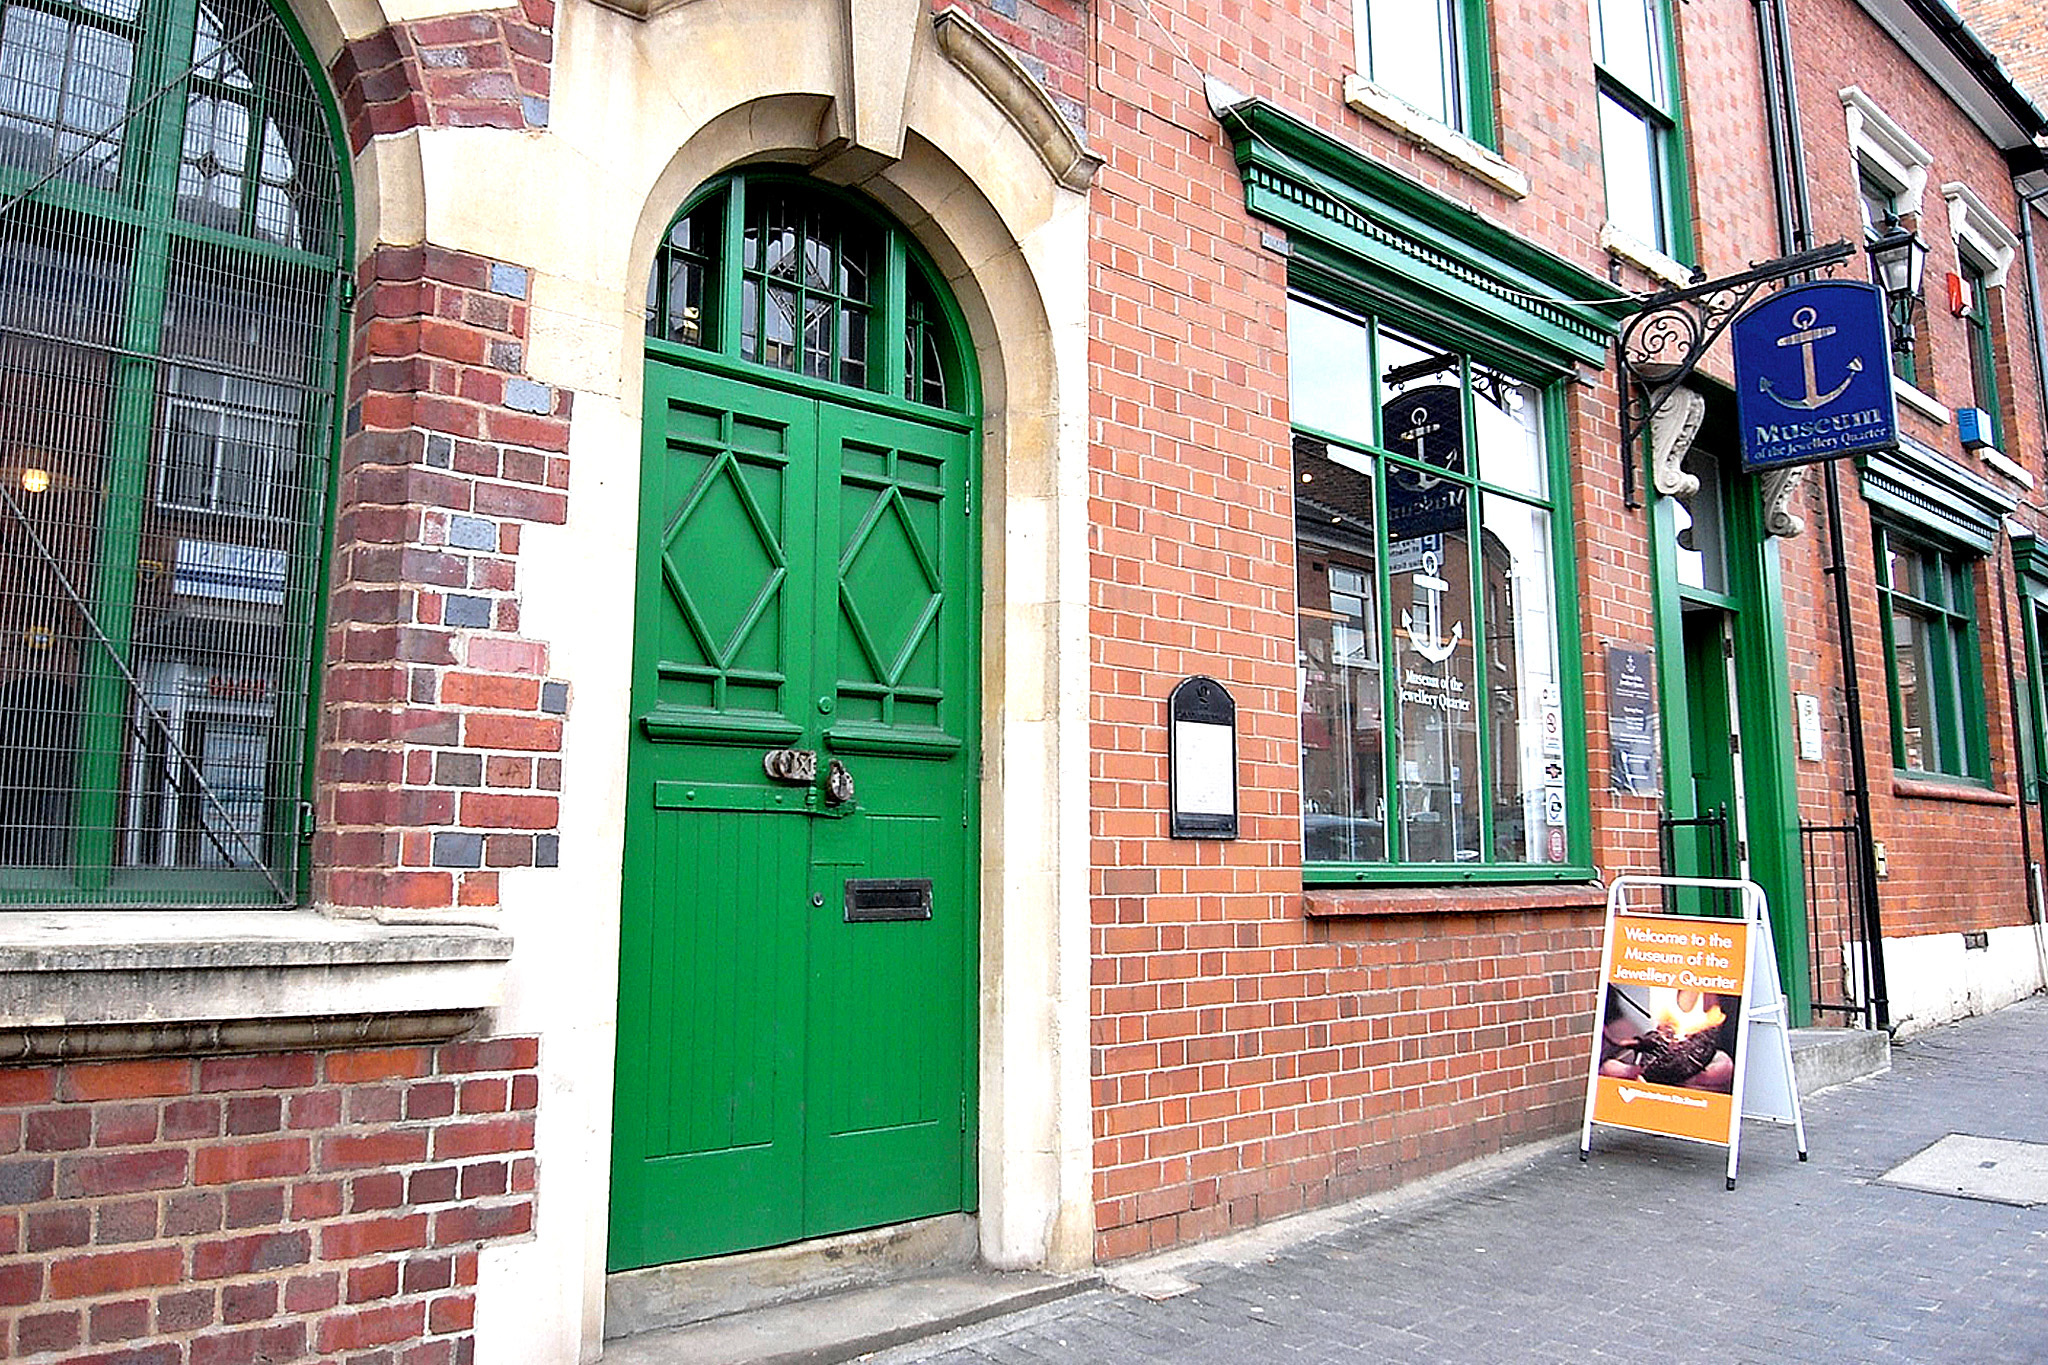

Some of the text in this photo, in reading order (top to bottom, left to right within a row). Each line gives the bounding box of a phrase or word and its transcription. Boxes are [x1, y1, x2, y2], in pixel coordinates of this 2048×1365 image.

[1756, 408, 1882, 446] Museum
[1754, 427, 1887, 460] of the Jewellery Quarter
[1405, 669, 1464, 692] Museum of the
[1398, 686, 1471, 711] Jewellery Quarter
[1624, 926, 1733, 949] Welcome to the
[1624, 946, 1729, 969] Museum of the
[1613, 964, 1738, 989] Jewellery Quarter
